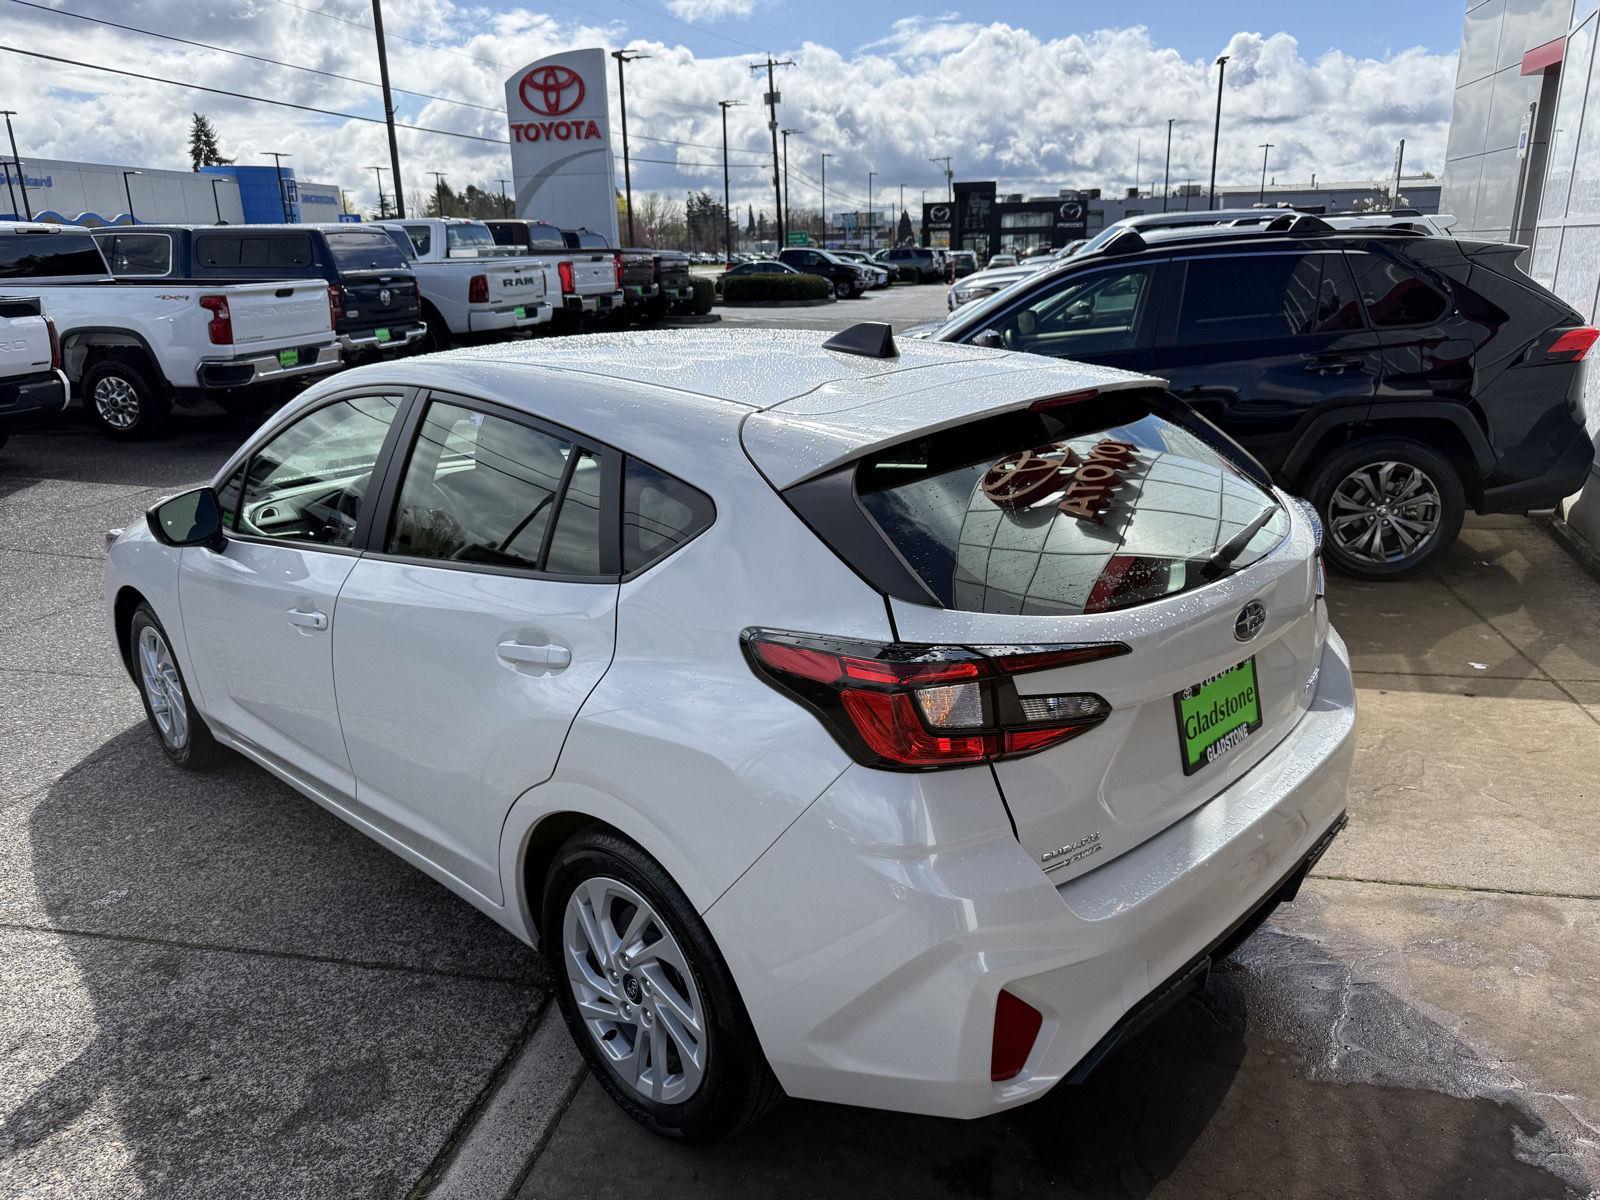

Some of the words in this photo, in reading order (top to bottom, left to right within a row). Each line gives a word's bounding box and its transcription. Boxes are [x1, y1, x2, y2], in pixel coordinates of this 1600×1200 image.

[511, 120, 602, 143] TOYOTA
[503, 277, 534, 287] RAM
[1185, 686, 1254, 740] Gladstone
[1206, 722, 1249, 763] GLADSTONE
[1041, 831, 1101, 861] SUBARU
